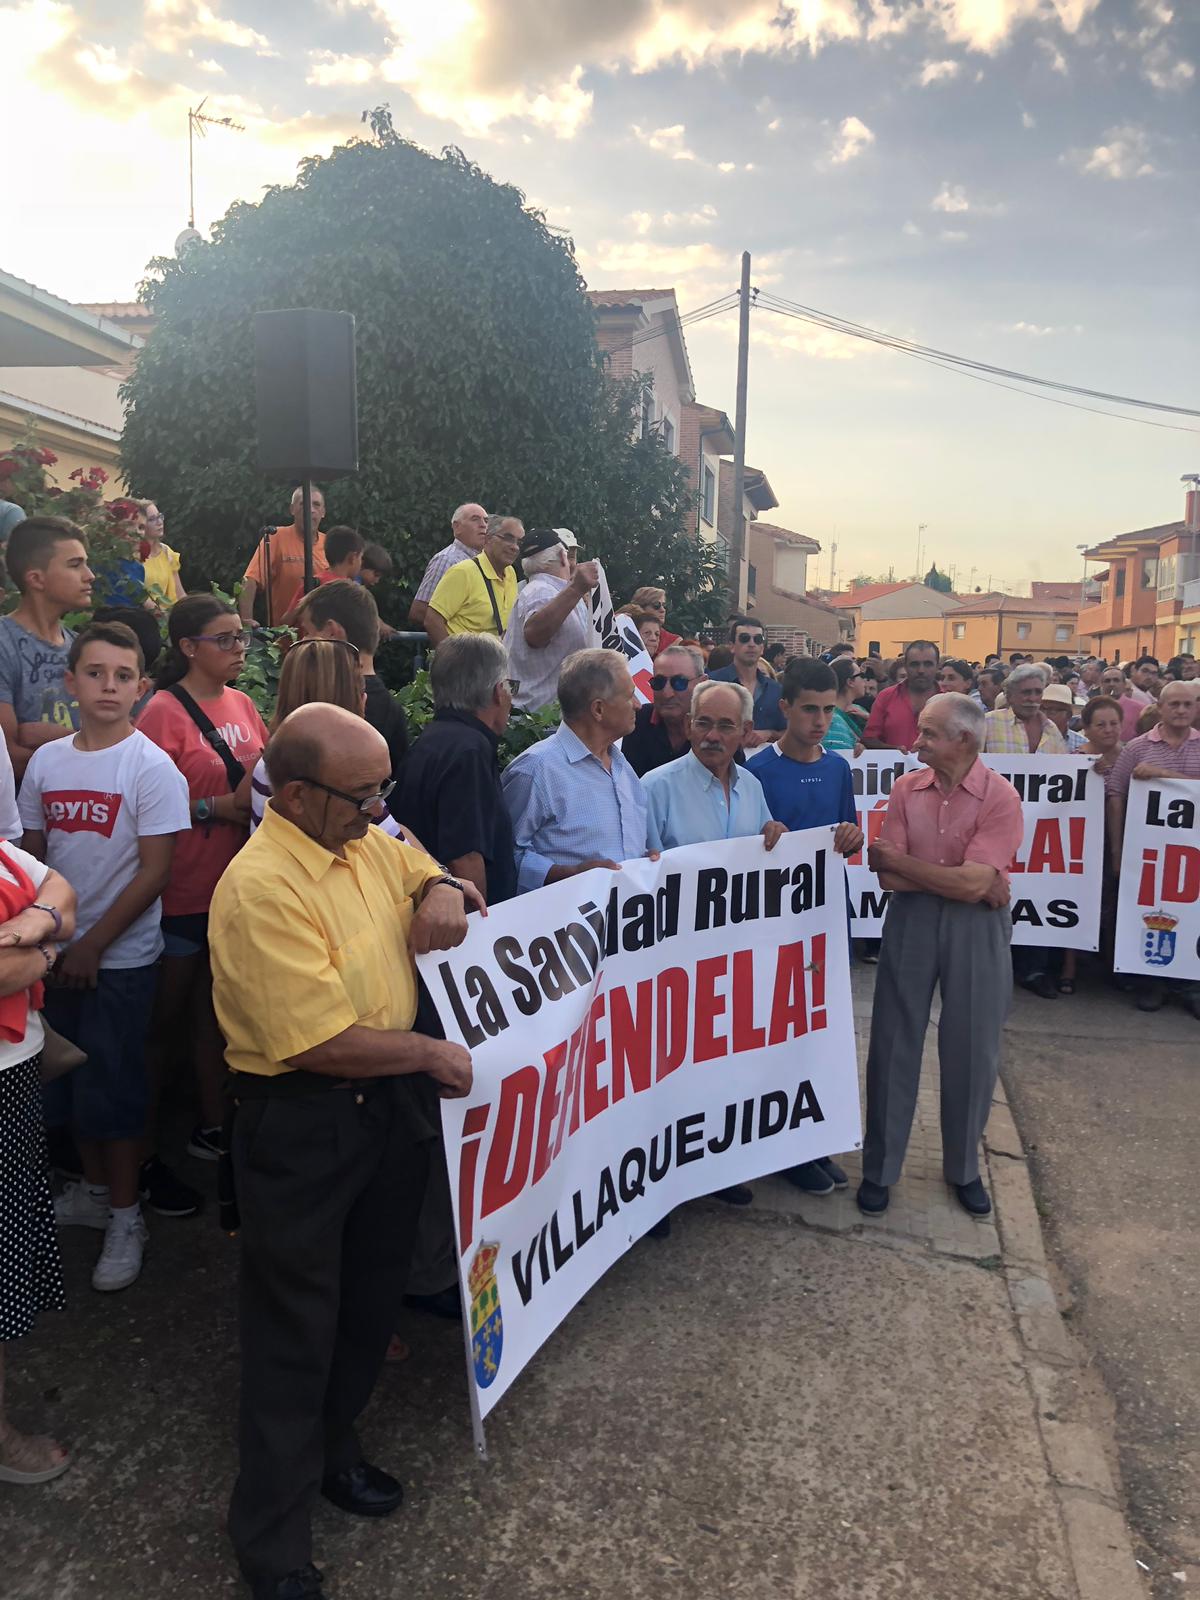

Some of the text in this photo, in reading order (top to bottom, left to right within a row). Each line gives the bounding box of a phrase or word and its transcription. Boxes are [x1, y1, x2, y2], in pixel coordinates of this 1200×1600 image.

[1145, 791, 1195, 829] La
[439, 849, 826, 1050] La Sanidad Rural
[511, 1079, 825, 1307] VILLAQUEJIDA
